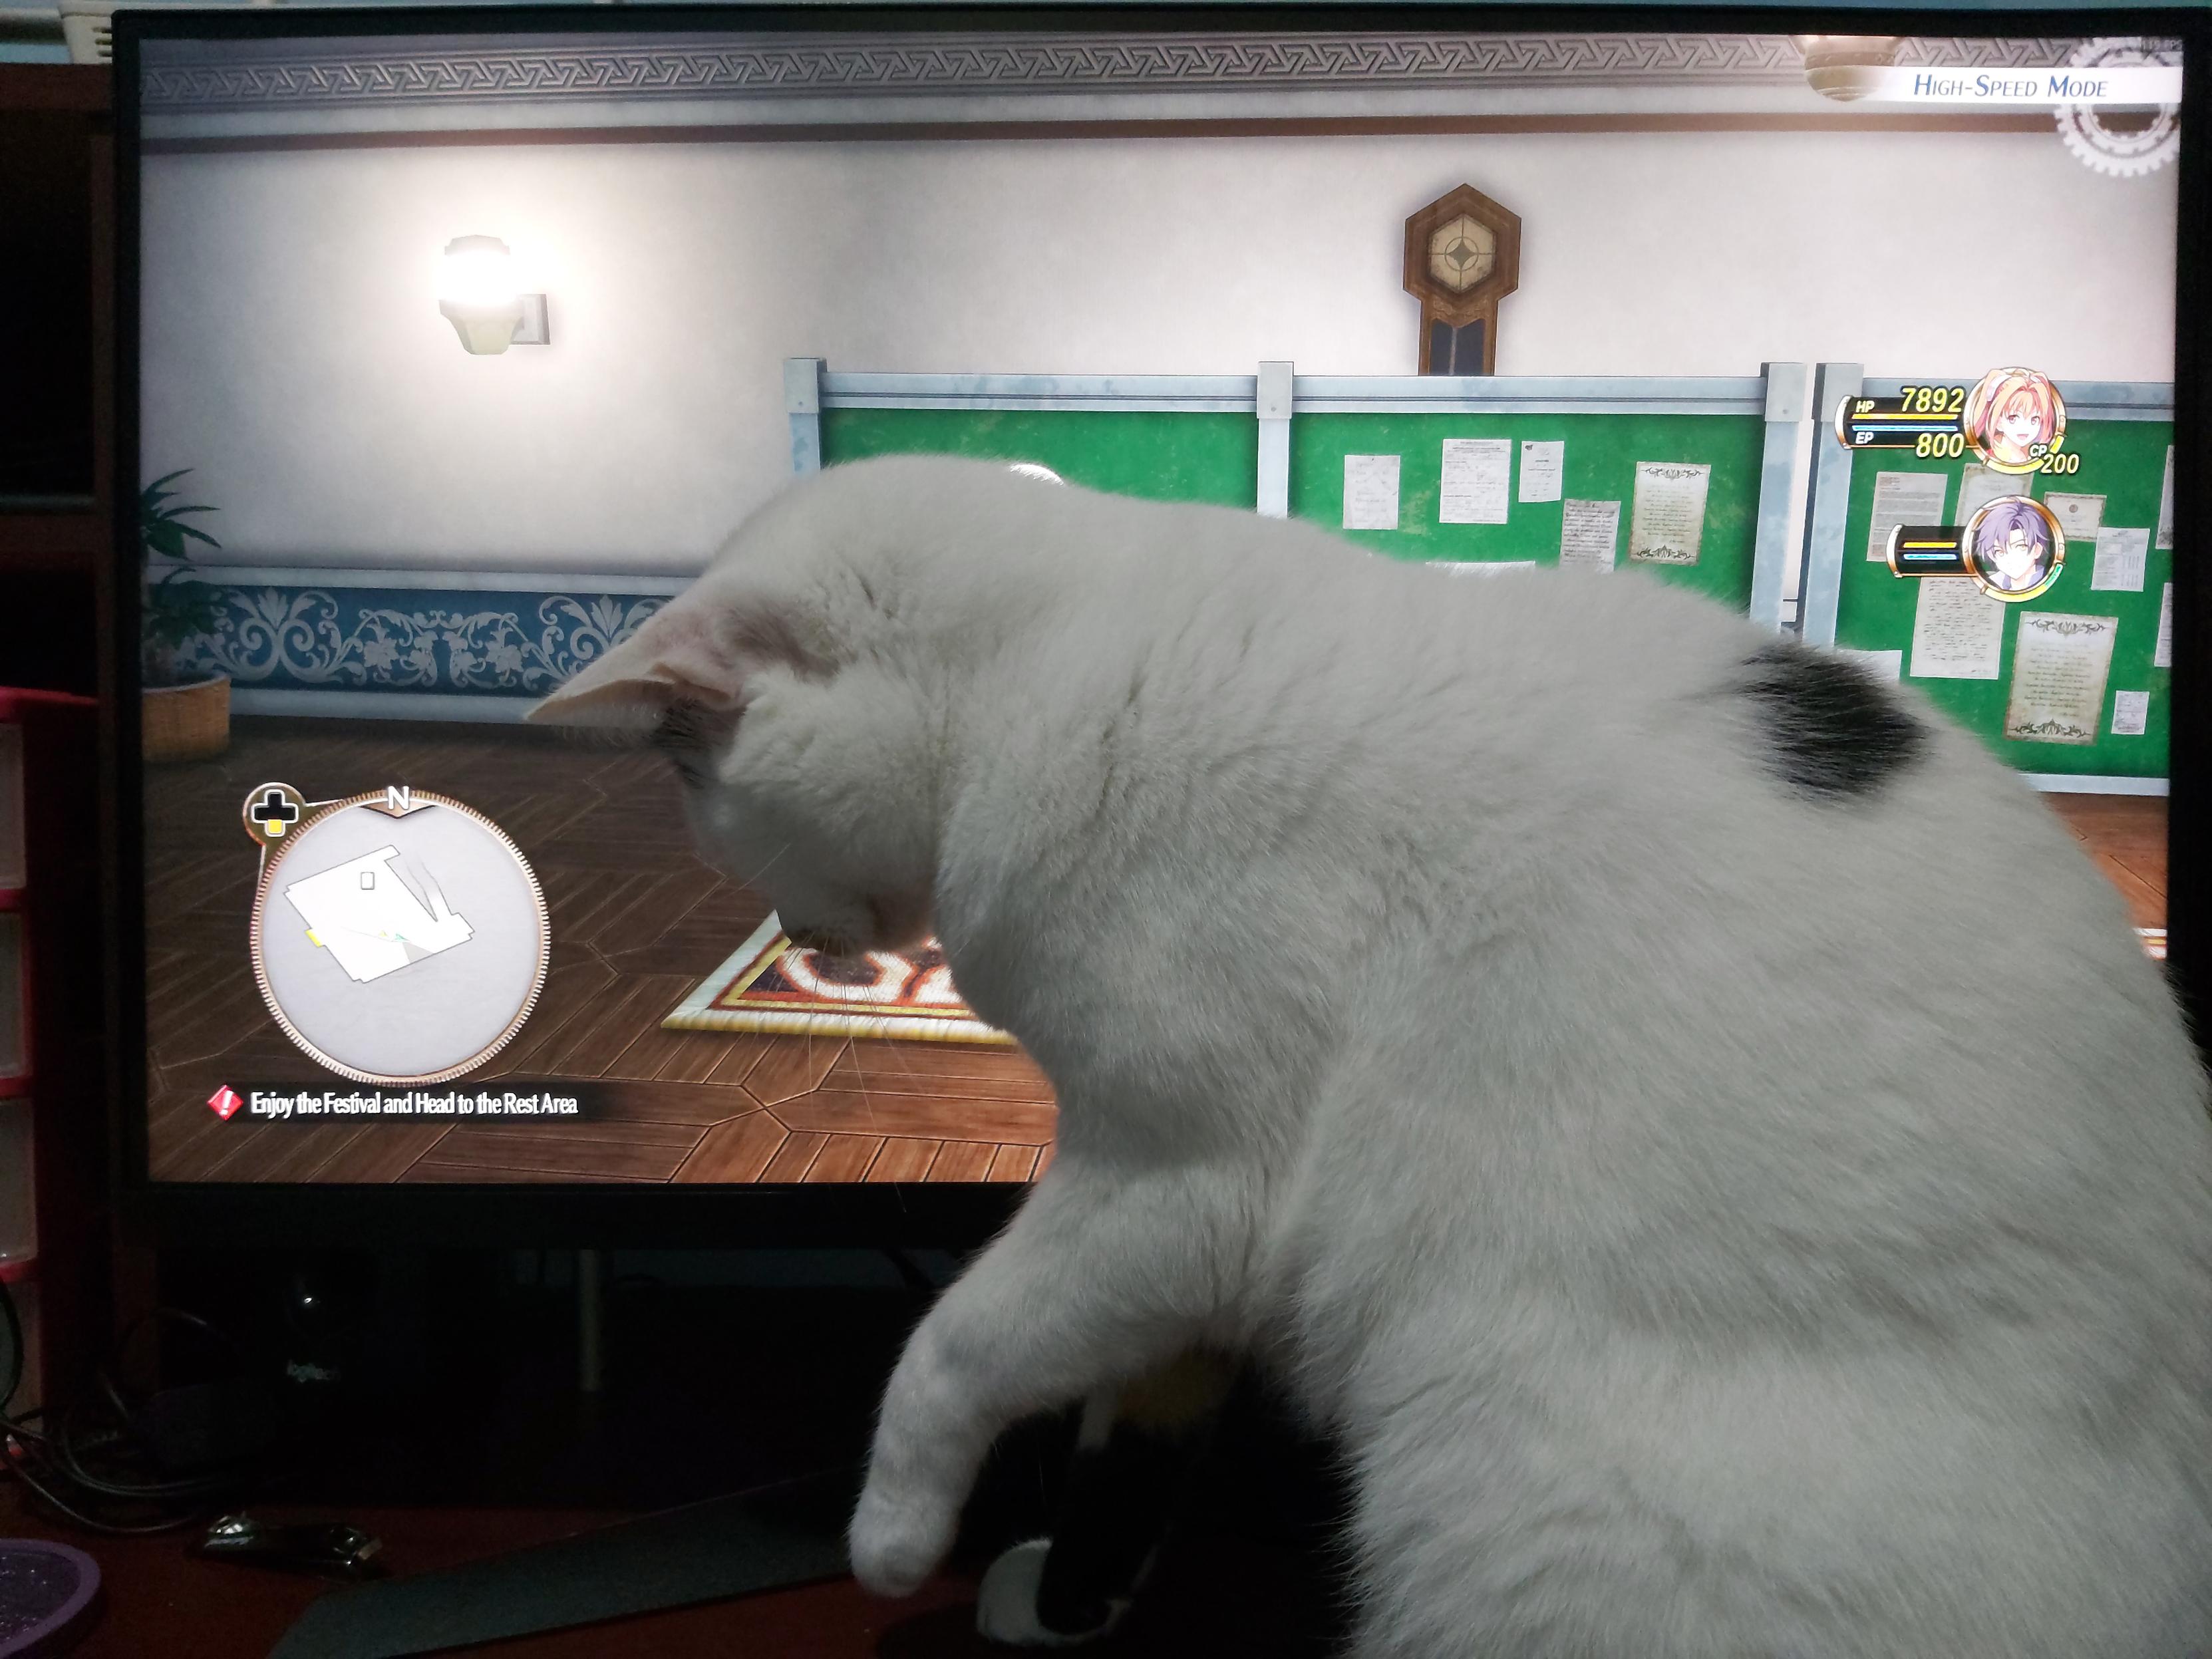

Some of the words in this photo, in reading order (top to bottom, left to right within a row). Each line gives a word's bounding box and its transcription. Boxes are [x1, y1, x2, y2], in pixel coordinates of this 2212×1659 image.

[1855, 400, 1875, 412] HP
[1901, 388, 1965, 412] 7892
[1855, 432, 1874, 444] EP
[1916, 433, 1964, 458] 800
[2030, 444, 2048, 456] CP
[2041, 454, 2080, 474] 200
[387, 786, 410, 810] N
[251, 1092, 295, 1119] Enjoy
[296, 1092, 322, 1114] the
[323, 1092, 381, 1114] Festival
[383, 1092, 414, 1114] and
[415, 1092, 455, 1114] Head
[457, 1094, 474, 1114] to
[476, 1092, 502, 1114] the
[504, 1093, 540, 1114] Rest
[540, 1093, 579, 1114] Area
